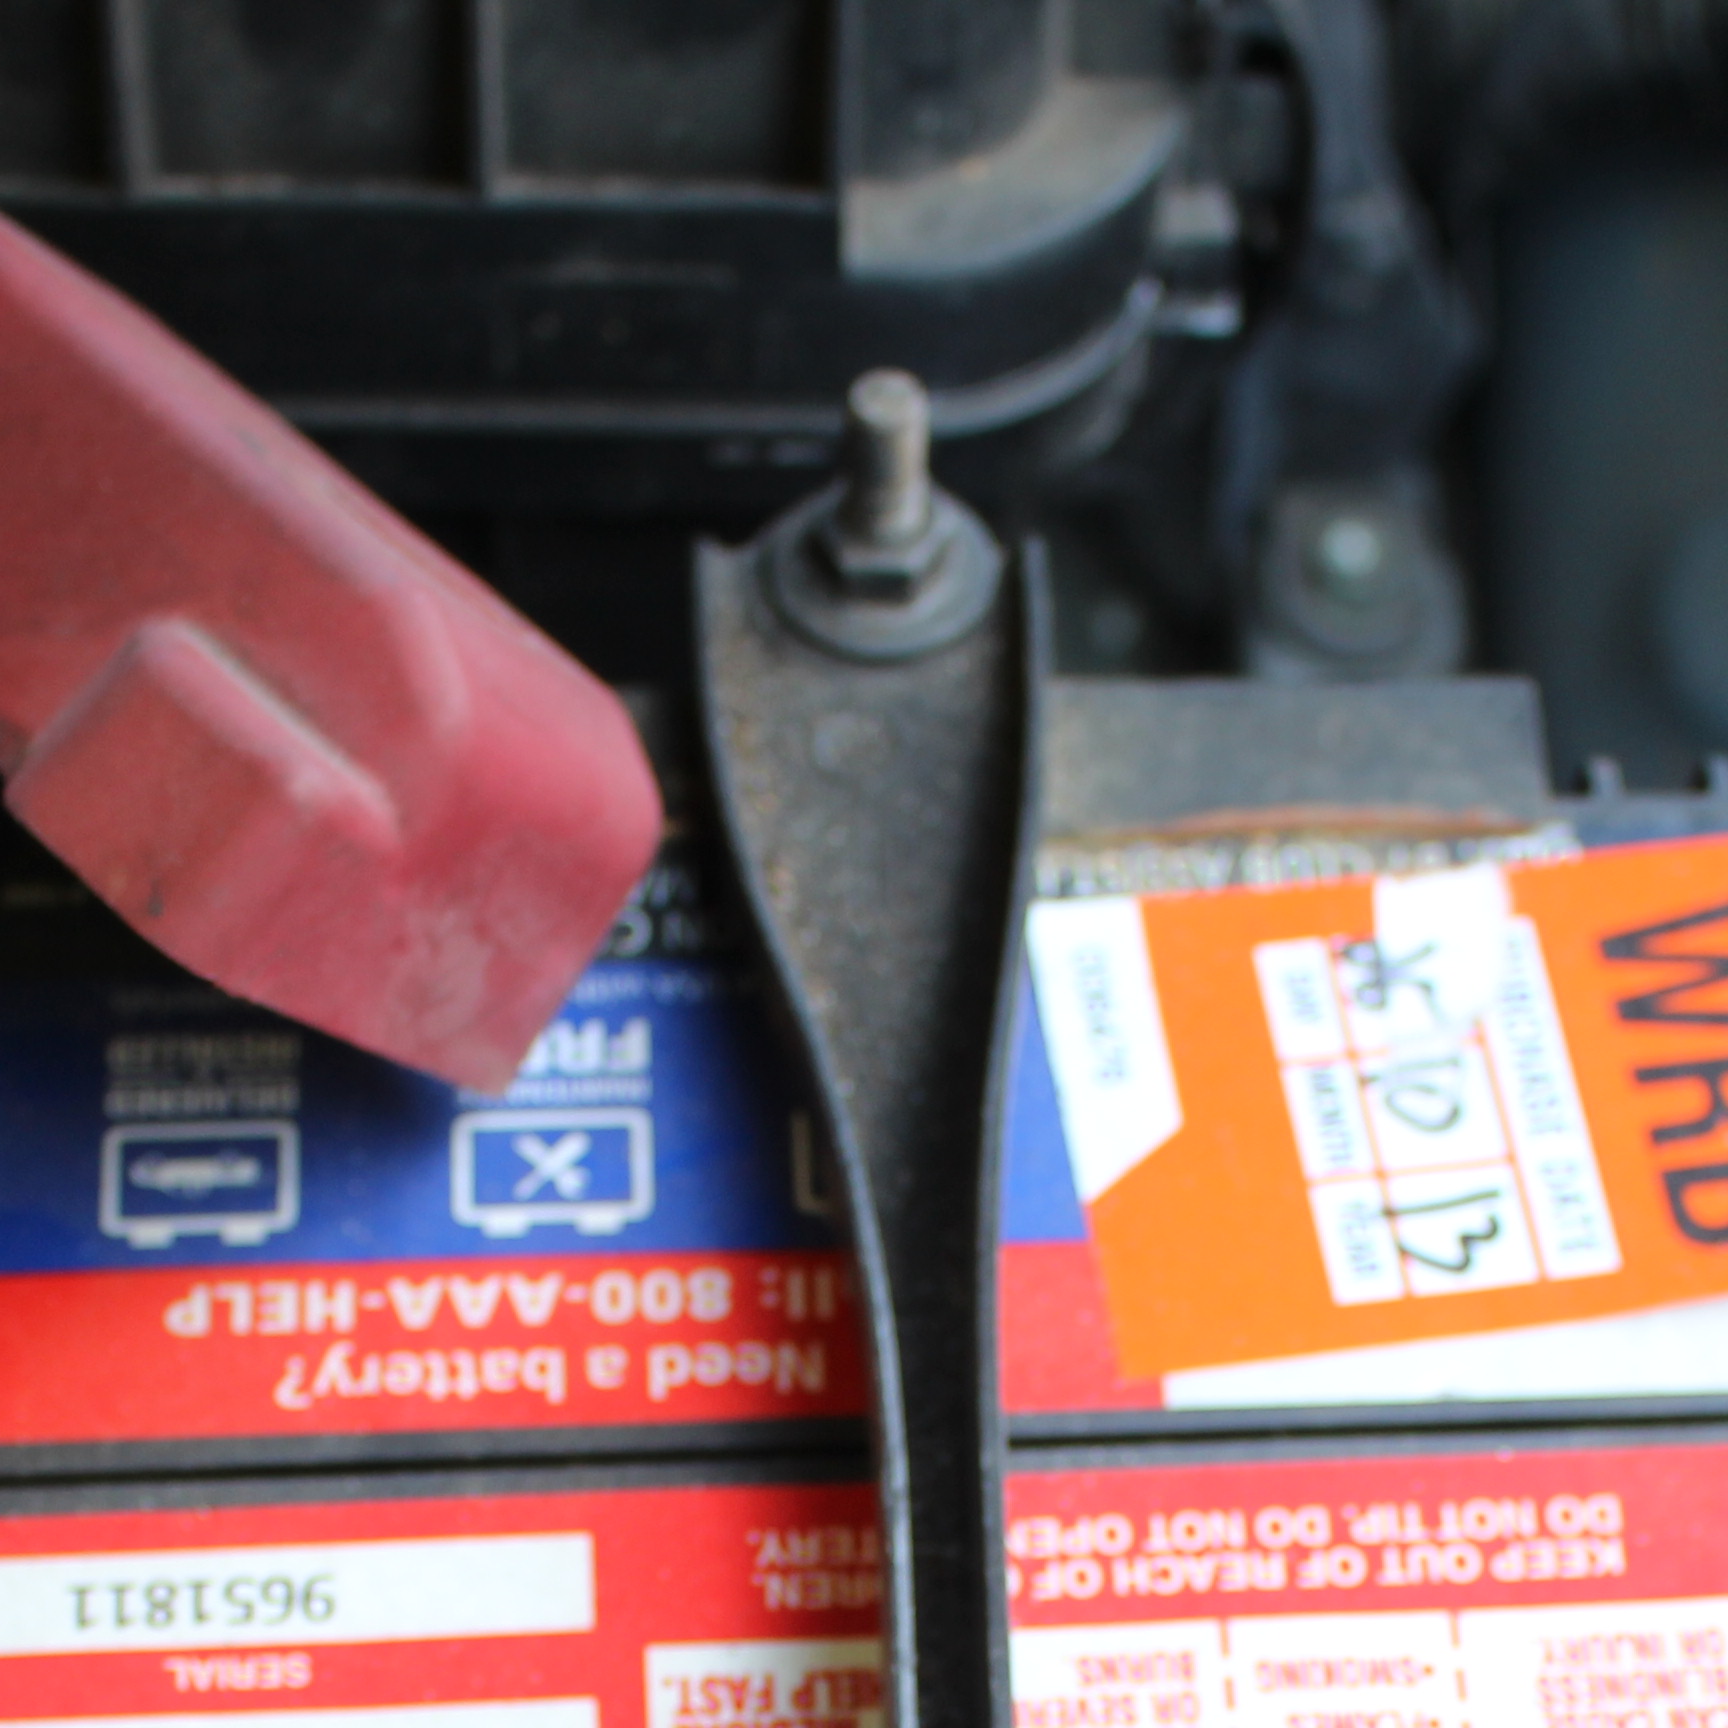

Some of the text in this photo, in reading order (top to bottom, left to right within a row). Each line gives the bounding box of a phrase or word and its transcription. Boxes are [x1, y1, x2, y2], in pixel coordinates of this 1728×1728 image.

[1381, 1191, 1503, 1276] 13
[164, 1266, 844, 1338] ll: 800-AAA-HELP
[274, 1340, 826, 1411] Need a battery?
[1146, 1508, 1248, 1554] NOT
[1254, 1504, 1331, 1549] DO
[1341, 1502, 1426, 1547] TIP.
[1438, 1497, 1537, 1543] NOT
[1545, 1493, 1625, 1538] DO
[1029, 1558, 1104, 1601] OF
[1114, 1550, 1288, 1596] REACH
[1293, 1544, 1369, 1590] OF
[1376, 1540, 1484, 1587] OUT
[1489, 1536, 1626, 1583] KEEP
[68, 1572, 336, 1631] 9651811
[163, 1651, 313, 1692] SERIAL
[662, 1672, 777, 1717] FAST.
[1149, 1690, 1199, 1725] OR
